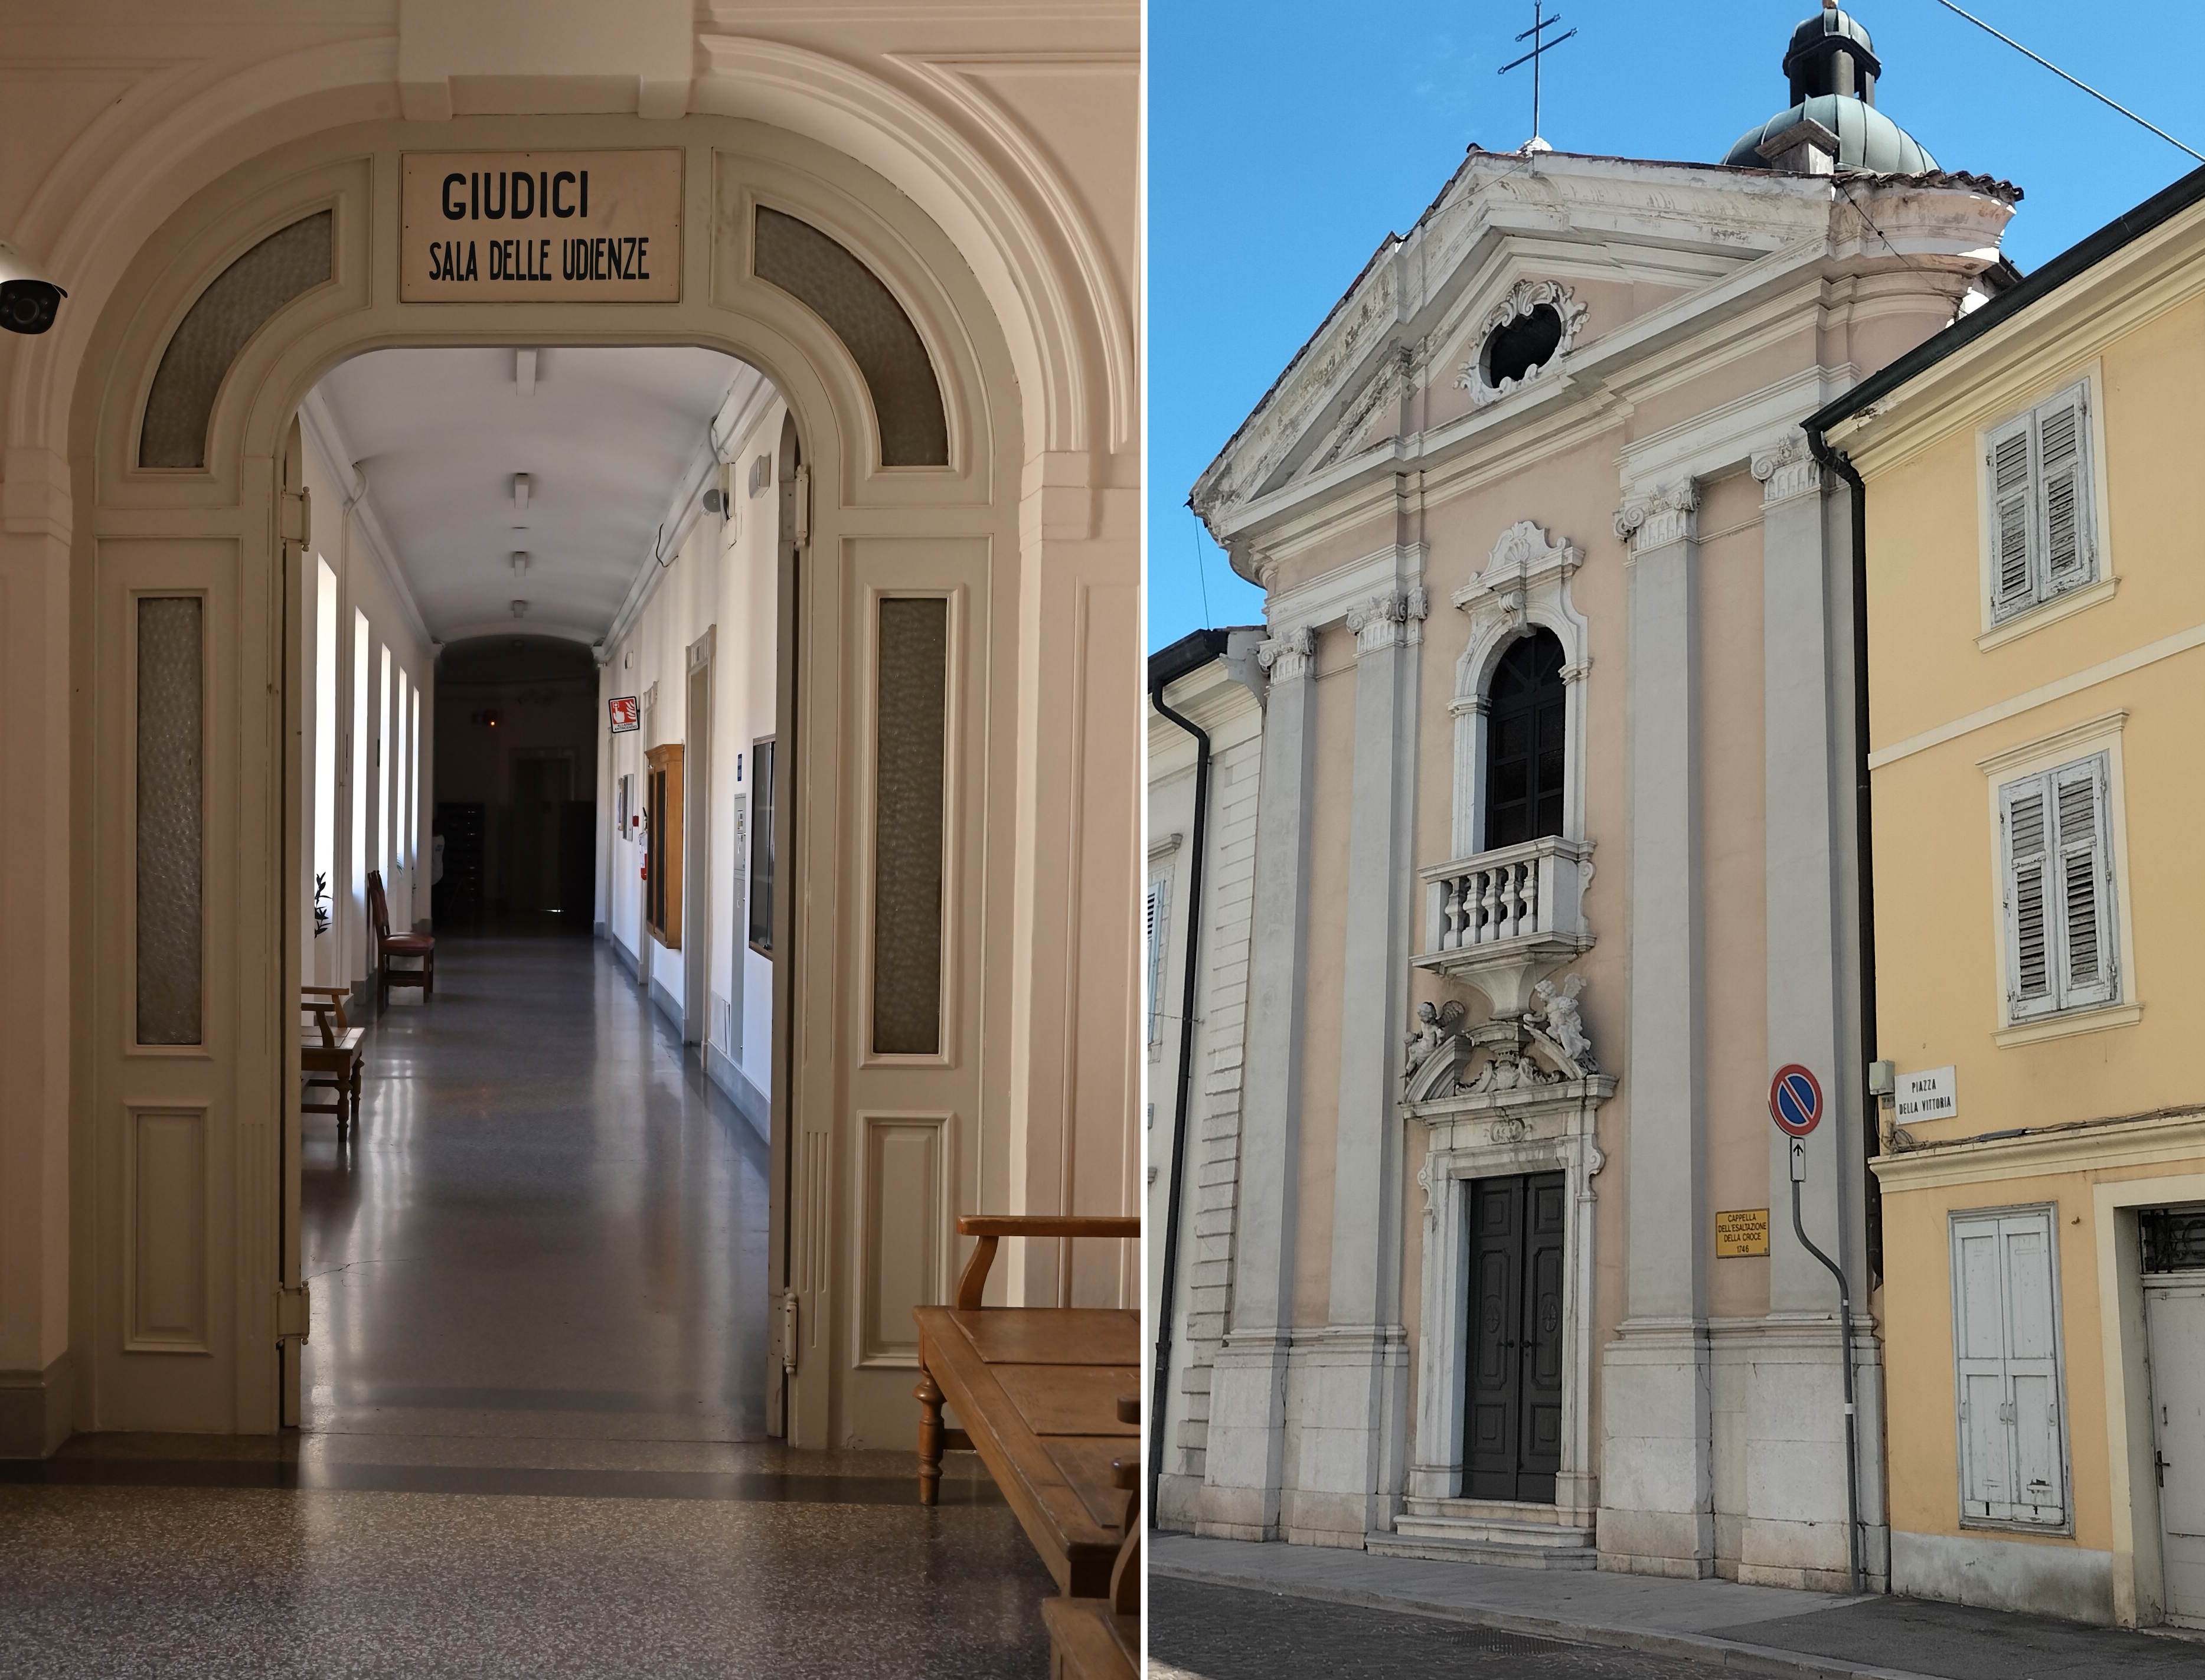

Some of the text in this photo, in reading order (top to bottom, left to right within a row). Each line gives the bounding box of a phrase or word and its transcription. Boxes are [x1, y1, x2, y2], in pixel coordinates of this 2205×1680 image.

[442, 171, 587, 220] GIUDICI
[429, 237, 649, 281] SALA DELLE UDIENZE
[1912, 1078, 1936, 1093] PIAZZA
[1899, 1096, 1951, 1115] DELLA VITTORIA
[1727, 1213, 1756, 1223] CAPPELLA
[1724, 1233, 1762, 1243] DELLA CROCE
[1736, 1244, 1749, 1253] 1746
